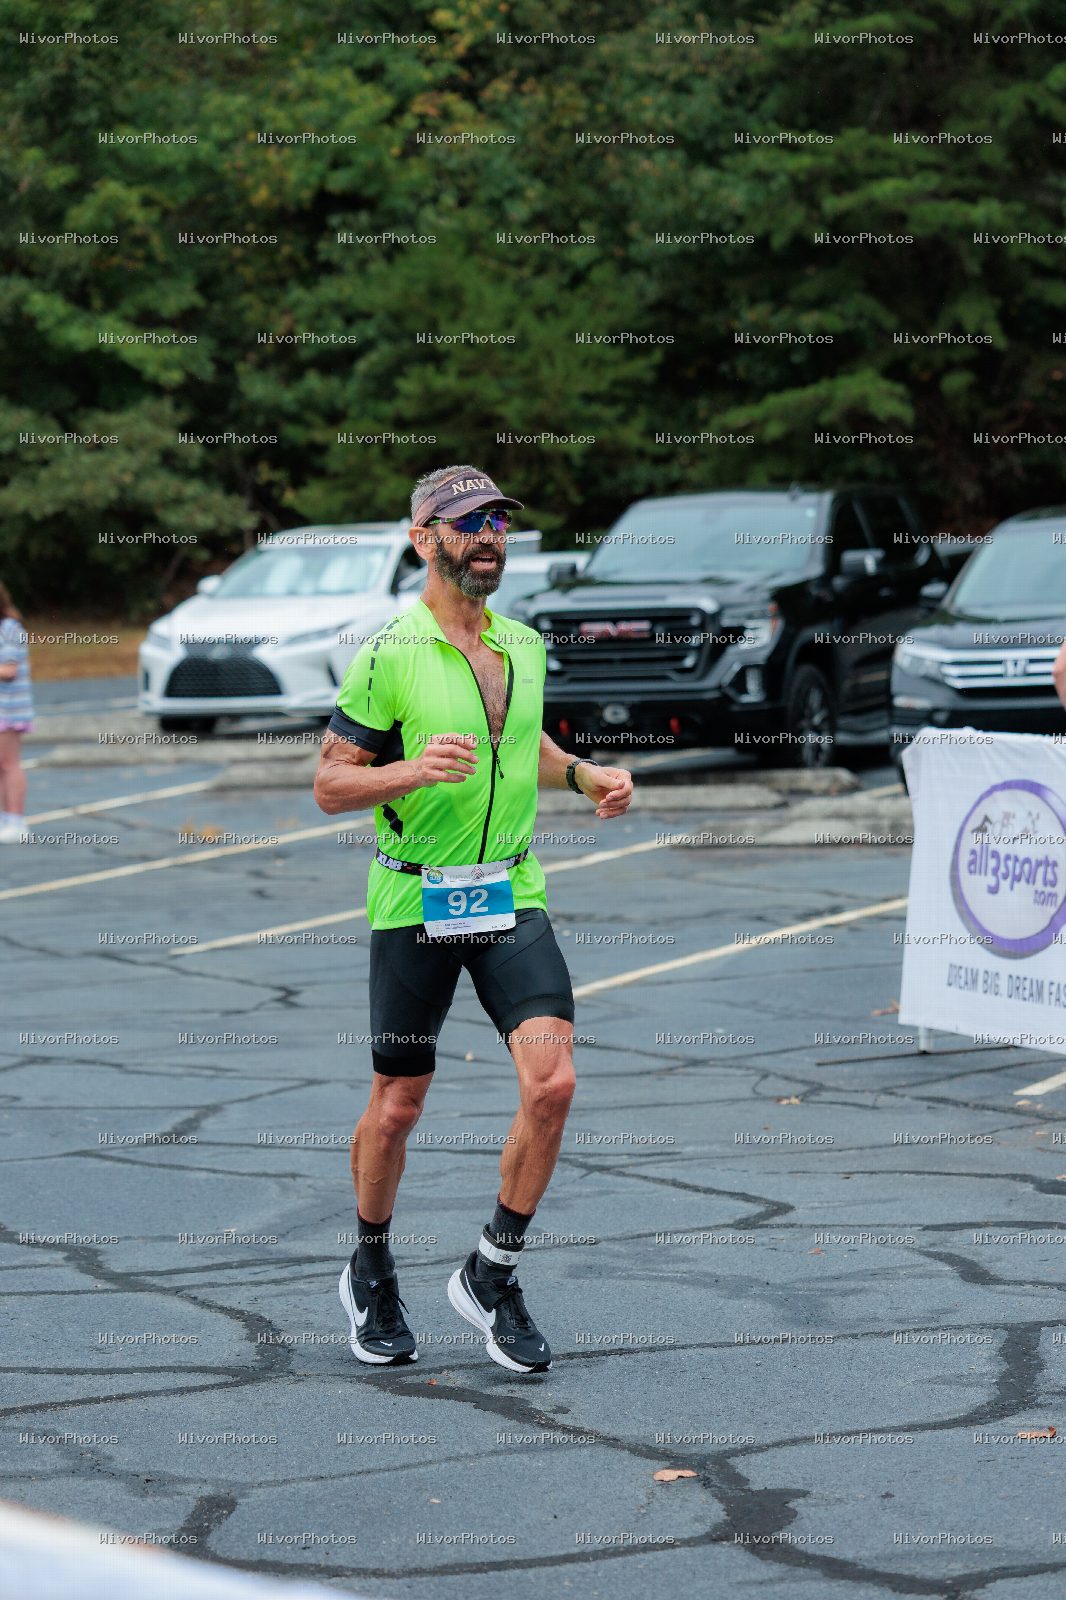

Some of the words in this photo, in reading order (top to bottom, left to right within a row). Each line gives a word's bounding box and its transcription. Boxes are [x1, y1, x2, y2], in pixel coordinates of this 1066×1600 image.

[452, 479, 497, 495] NAVY
[447, 888, 489, 916] 92
[947, 963, 979, 993] DREAM
[1007, 973, 1044, 1005] DREAM
